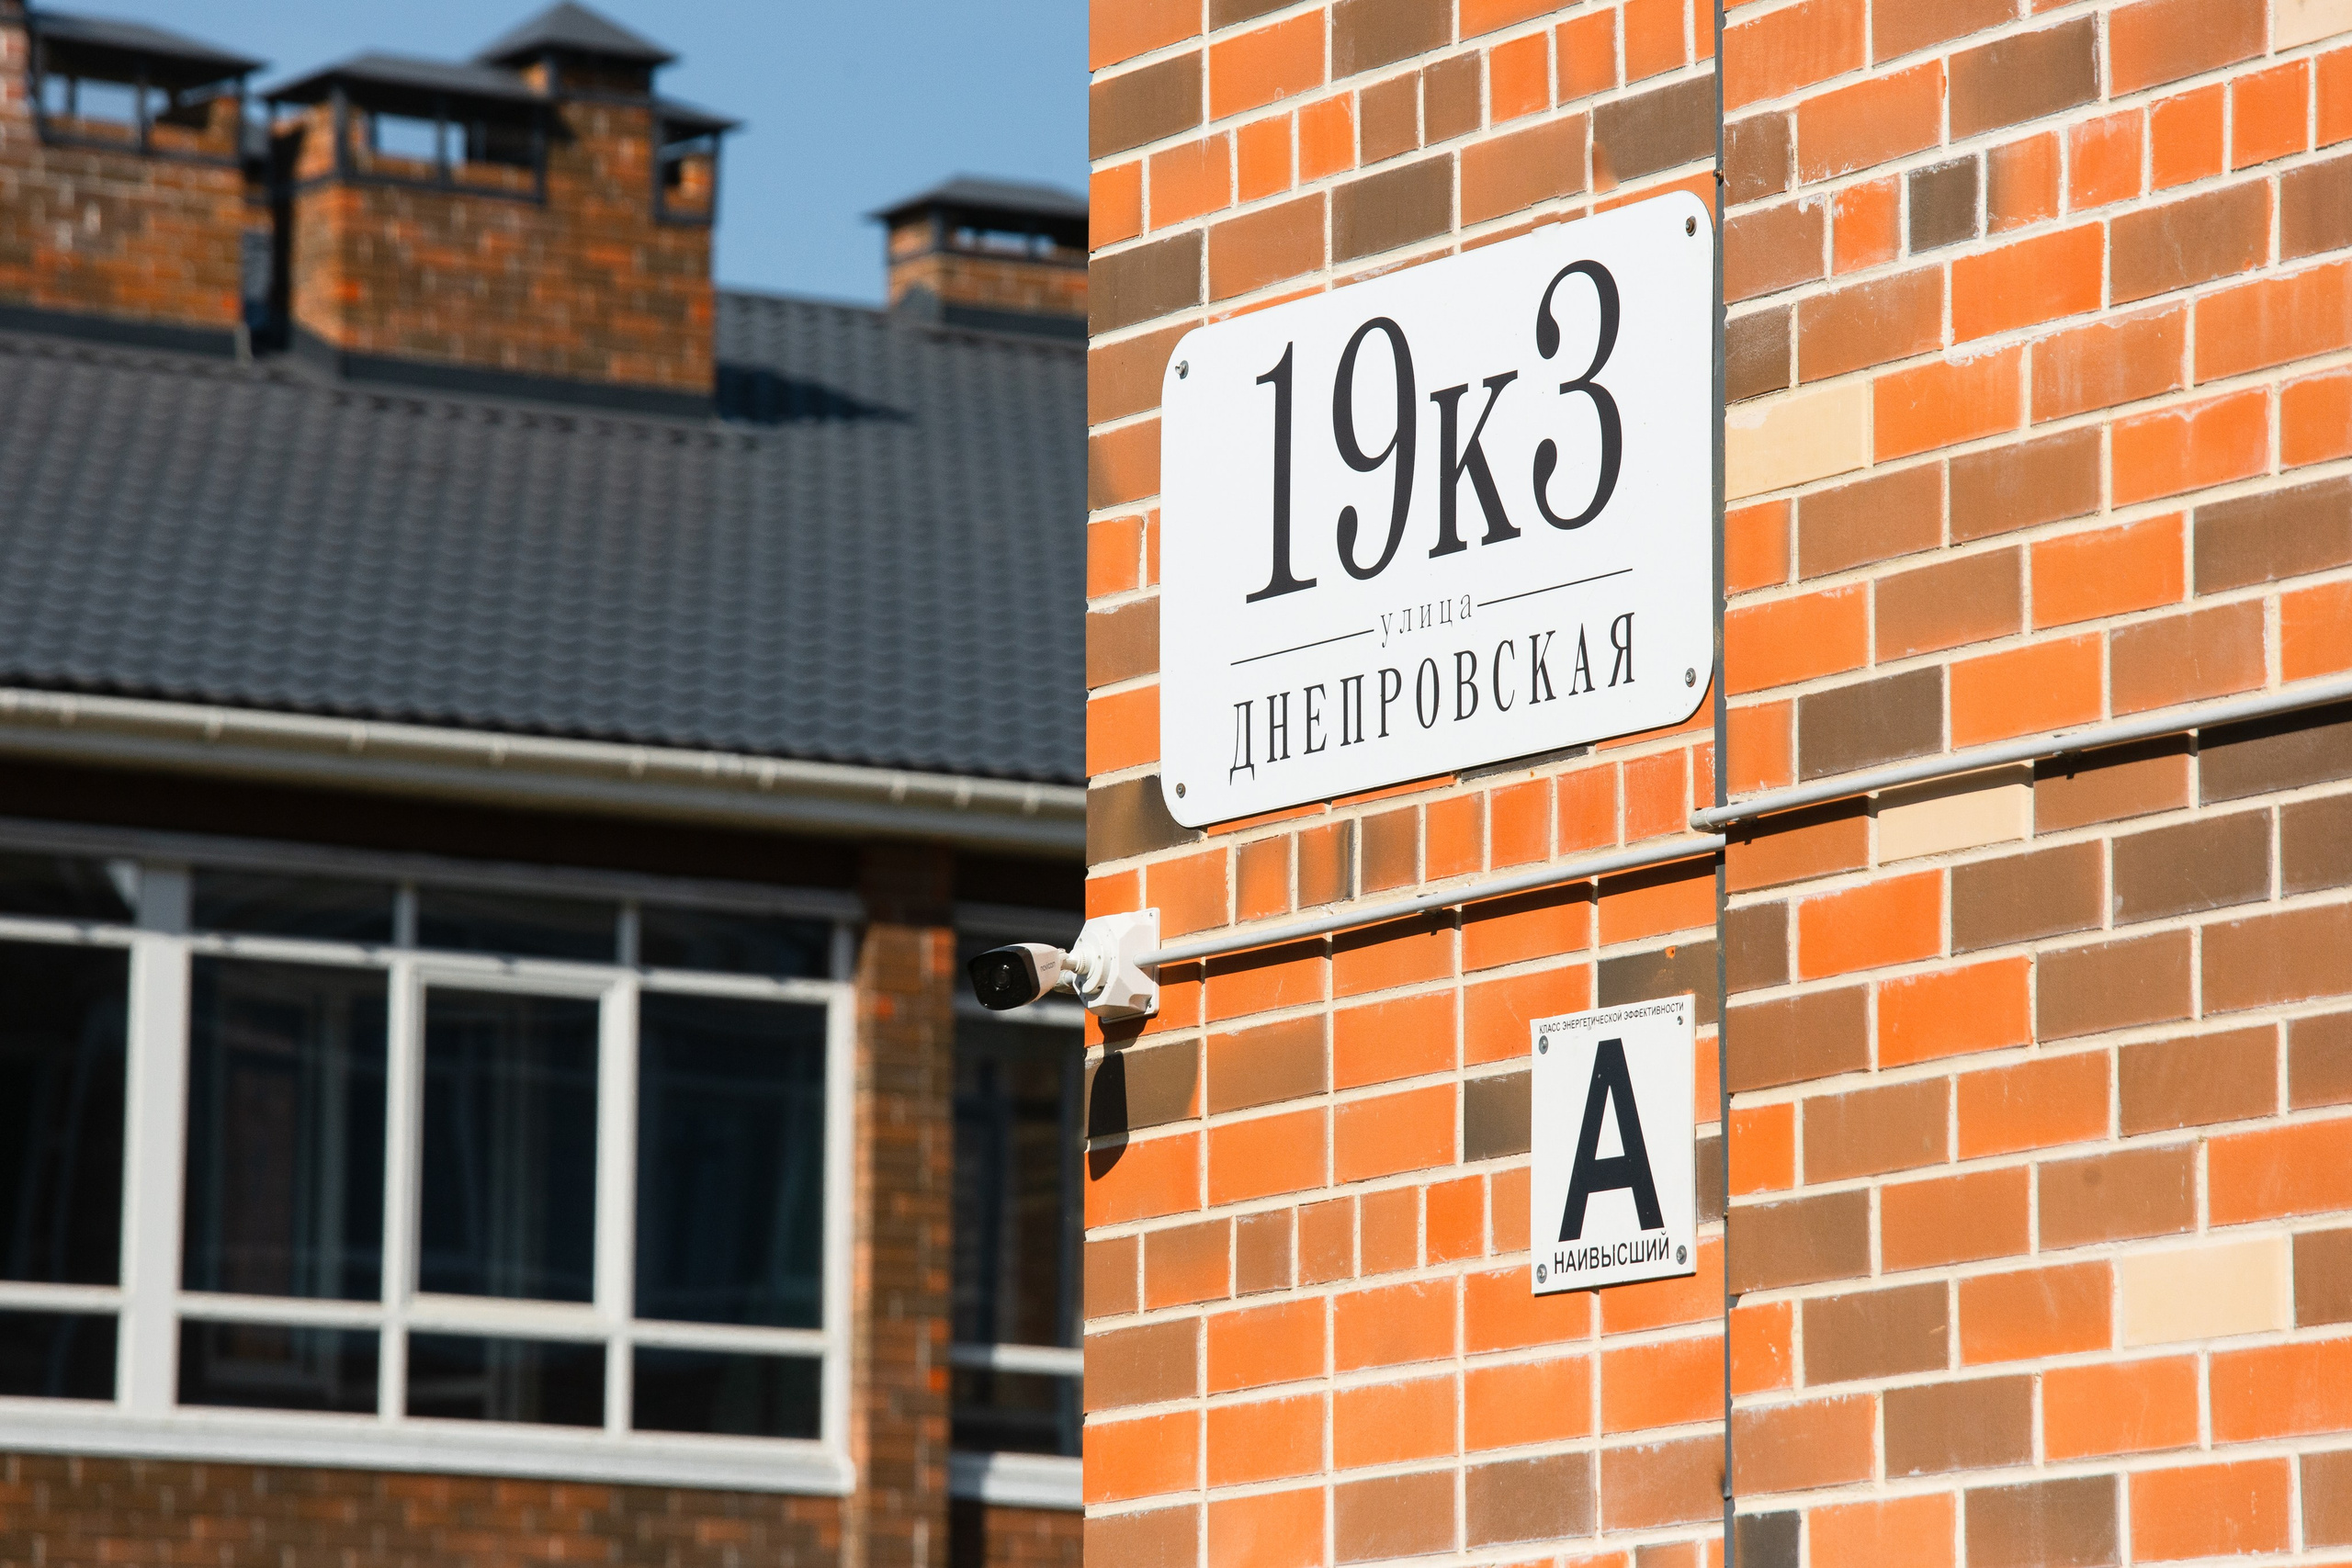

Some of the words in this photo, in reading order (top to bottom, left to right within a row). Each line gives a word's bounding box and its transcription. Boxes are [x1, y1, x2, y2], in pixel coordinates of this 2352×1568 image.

[1246, 259, 1623, 604] 19к3
[1379, 592, 1474, 649] улица
[1229, 612, 1635, 786] ДНЕПРОВСКАЯ
[1539, 1021, 1561, 1034] КЛАСС
[1562, 1010, 1623, 1031] ЭНЕРГЕТИЧЕСКОЙ
[1623, 1001, 1684, 1021] ЭФФЕКТИВНОСТИ
[1557, 1037, 1665, 1243] А
[1554, 1231, 1669, 1275] НАИВЫСШИЙ
